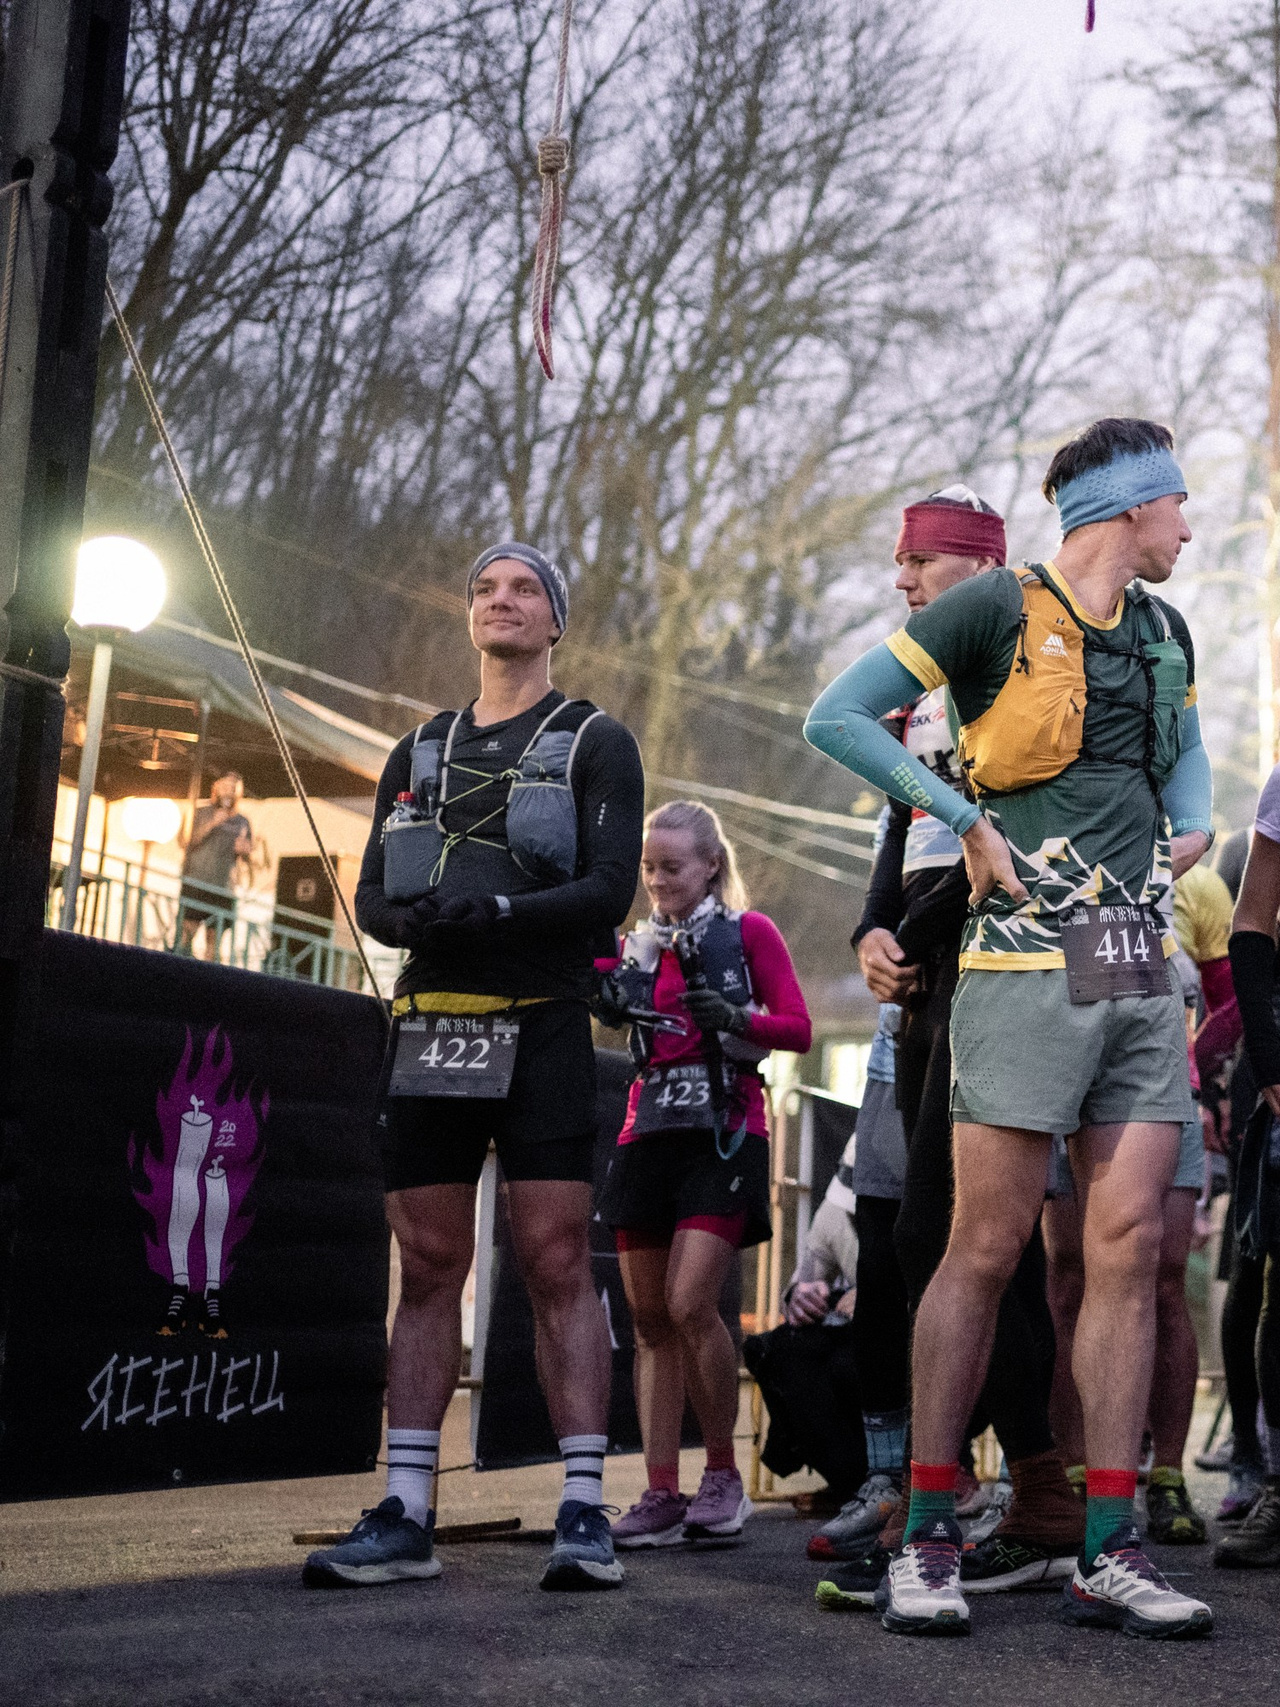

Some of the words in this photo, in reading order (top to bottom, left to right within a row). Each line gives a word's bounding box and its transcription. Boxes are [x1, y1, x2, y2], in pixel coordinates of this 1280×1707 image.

[1094, 927, 1150, 964] 414
[418, 1037, 490, 1069] 422
[655, 1081, 710, 1108] 423
[219, 1120, 236, 1133] 20
[214, 1134, 236, 1147] 22
